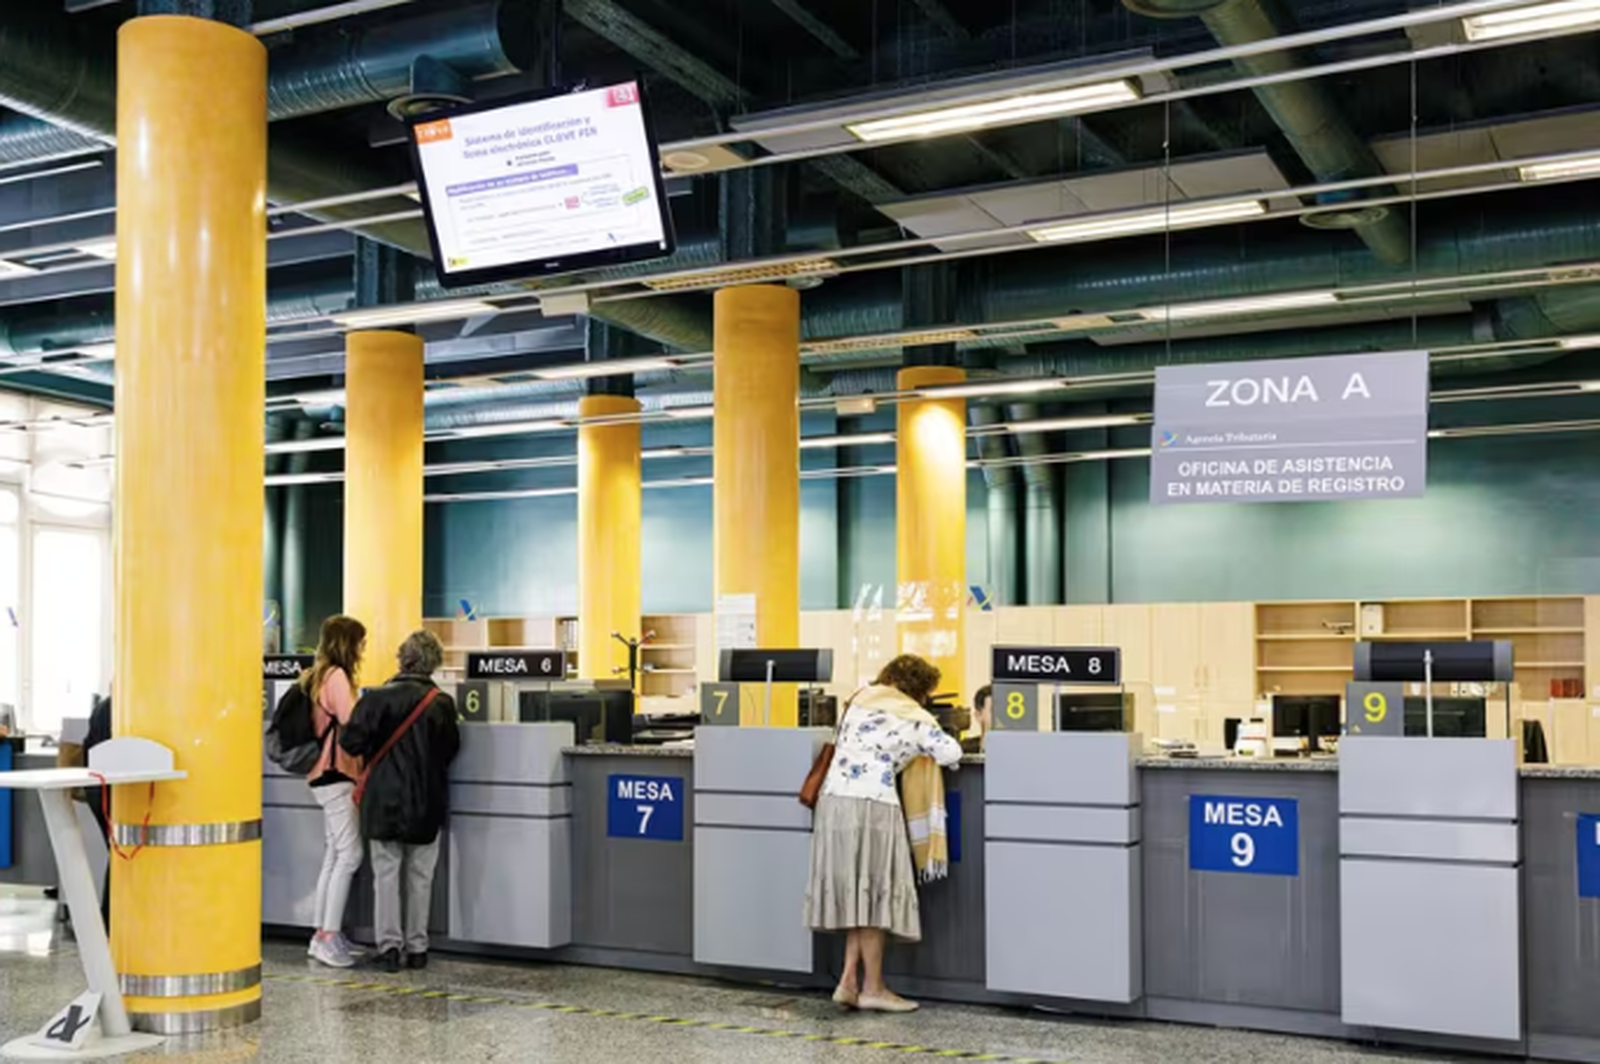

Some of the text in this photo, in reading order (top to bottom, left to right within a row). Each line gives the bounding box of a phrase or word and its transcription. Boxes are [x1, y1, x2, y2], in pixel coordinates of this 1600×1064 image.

[503, 128, 516, 139] de
[1205, 372, 1371, 407] ZONA A
[1184, 432, 1277, 445] Agencia Tributaria
[1178, 456, 1393, 477] OFICINA DE ASISTENCIA
[1167, 476, 1405, 496] EN MATERIA DE REGISTRO
[478, 658, 552, 673] MESA 6
[1008, 655, 1101, 674] MESA 8
[466, 689, 480, 713] 6
[713, 691, 729, 715] 7
[1006, 692, 1025, 719] 8
[1363, 692, 1387, 723] 9
[618, 780, 674, 801] MESA
[637, 805, 654, 834] 7
[1204, 802, 1283, 827] MESA
[1231, 832, 1255, 867] 9
